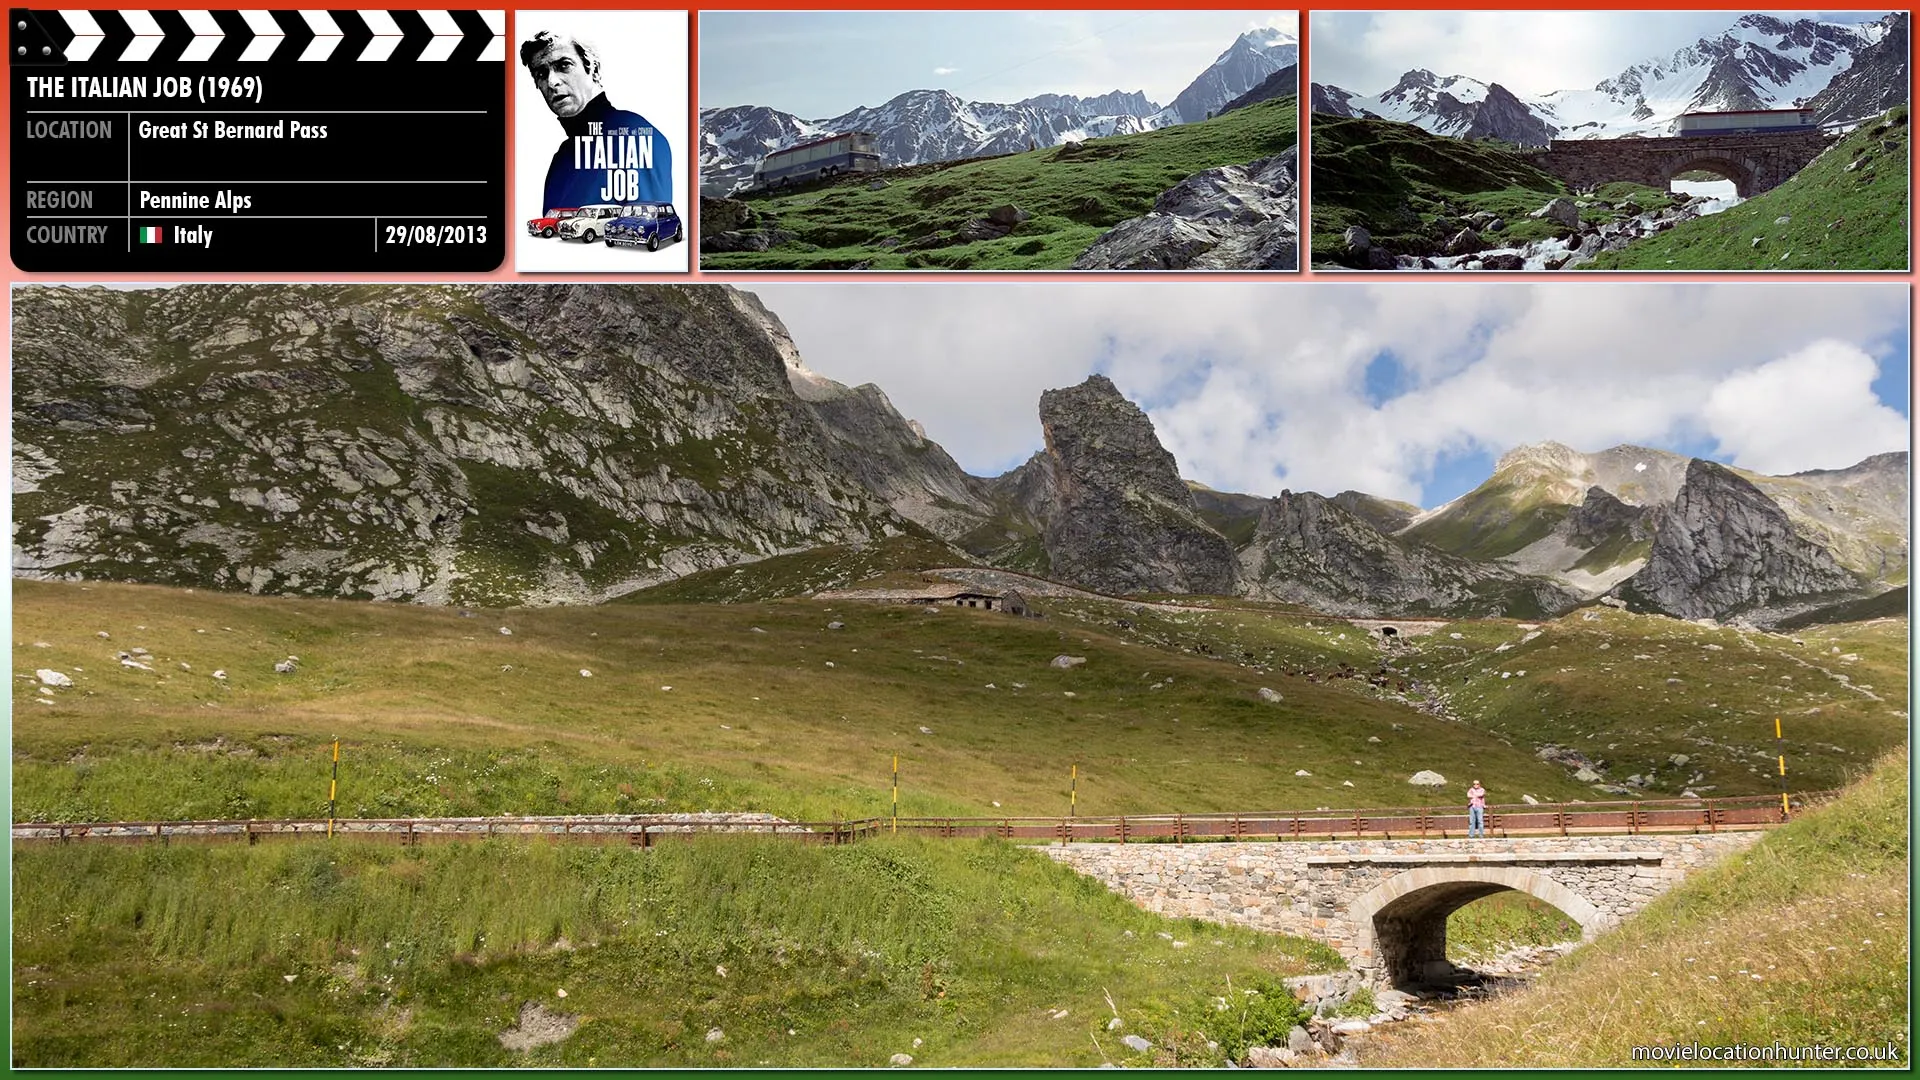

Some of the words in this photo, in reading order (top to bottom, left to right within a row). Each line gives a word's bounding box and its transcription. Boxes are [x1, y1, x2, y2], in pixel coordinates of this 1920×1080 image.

[588, 122, 603, 136] THE
[575, 136, 653, 169] ITALIAN
[601, 169, 639, 201] JOB
